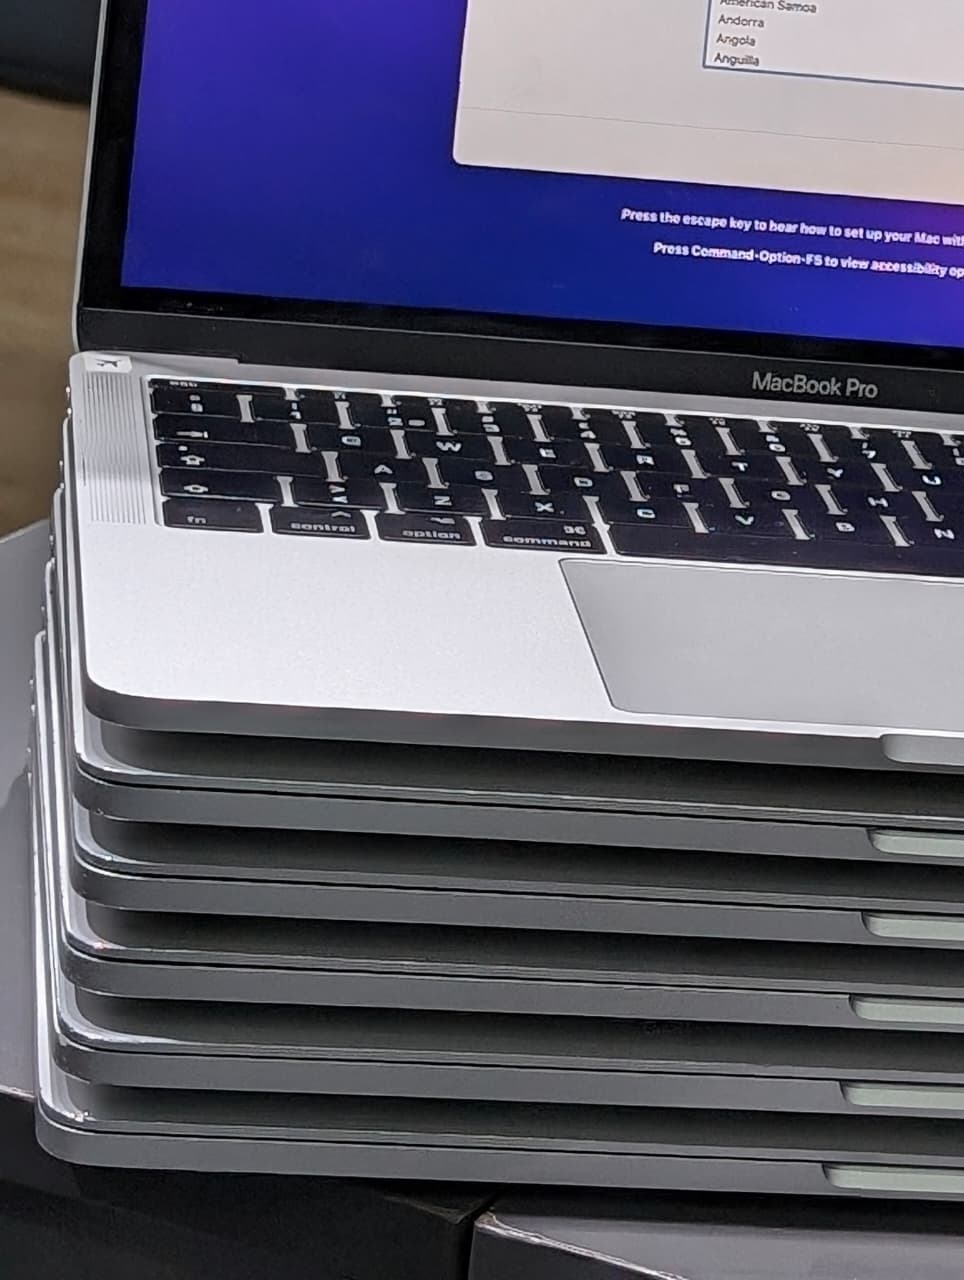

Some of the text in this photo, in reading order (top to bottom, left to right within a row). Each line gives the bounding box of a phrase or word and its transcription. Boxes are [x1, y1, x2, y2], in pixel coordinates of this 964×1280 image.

[777, 0, 817, 14] Samoa
[718, 14, 765, 28] Andorra
[716, 33, 756, 49] Angola
[714, 52, 760, 68] Anguilla
[621, 208, 657, 223] Press
[659, 211, 680, 225] the
[683, 214, 727, 231] escape
[729, 216, 752, 233] key
[754, 219, 767, 232] to
[769, 220, 798, 235] hear
[800, 222, 827, 236] how
[829, 225, 842, 237] to
[844, 226, 864, 239] set
[866, 229, 882, 244] up
[884, 230, 912, 246] your
[914, 232, 940, 246] Mac
[653, 242, 689, 257] Press
[824, 255, 838, 268] to
[840, 257, 869, 271] view
[870, 260, 947, 280] accessibility
[752, 371, 878, 399] MacBook Pro
[290, 522, 356, 534] control
[402, 529, 462, 541] option
[502, 535, 592, 549] command
